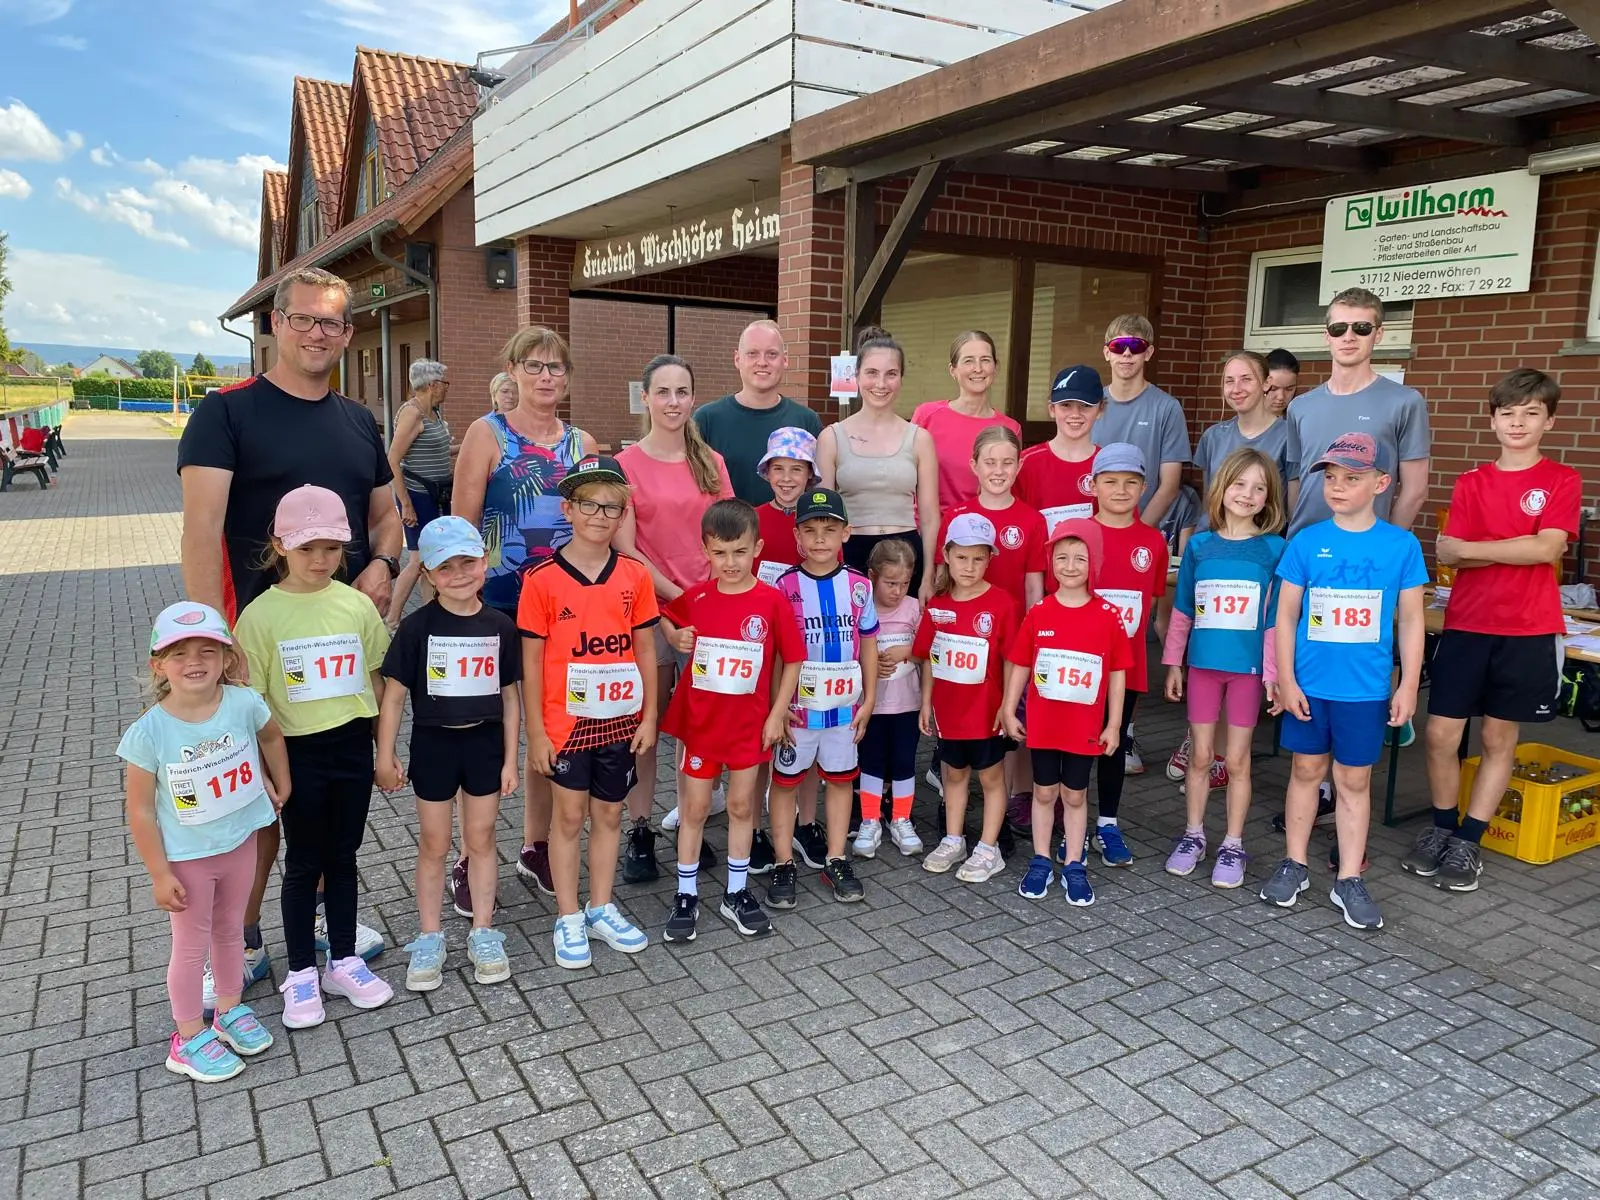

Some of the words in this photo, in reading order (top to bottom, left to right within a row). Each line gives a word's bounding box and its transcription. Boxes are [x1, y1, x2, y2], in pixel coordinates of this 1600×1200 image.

[1376, 187, 1495, 221] wilharm
[582, 241, 635, 279] Friedrich
[640, 218, 723, 268] Wischhöfer
[731, 206, 780, 252] Heim
[1379, 234, 1411, 244] Garten-
[1412, 230, 1429, 240] und
[1430, 222, 1500, 237] Landschaftsbau
[1377, 248, 1440, 262] Pflasterarbeiten
[1442, 245, 1462, 255] aller
[1464, 244, 1477, 253] Art
[1378, 243, 1396, 253] Tief-
[1397, 241, 1413, 250] und
[1414, 236, 1464, 248] Straßenbau
[1359, 272, 1390, 285] 31712
[1392, 266, 1481, 282] Niedernwöhren
[1378, 286, 1389, 297] 21
[1401, 285, 1414, 296] 22
[1417, 283, 1430, 295] 22
[1441, 282, 1464, 293] Fax:
[1469, 280, 1476, 291] 7
[1479, 278, 1493, 290] 29
[1497, 277, 1512, 289] 22
[1213, 595, 1250, 614] 137
[1331, 607, 1371, 627] 183
[571, 631, 632, 658] Jeep
[805, 633, 820, 644] FLY
[314, 653, 355, 679] 177
[457, 656, 495, 678] 176
[716, 656, 753, 679] 175
[945, 649, 978, 671] 180
[824, 677, 854, 696] 181
[1057, 666, 1093, 689] 154
[596, 680, 634, 702] 182
[207, 760, 253, 799] 178
[1485, 826, 1515, 842] oke
